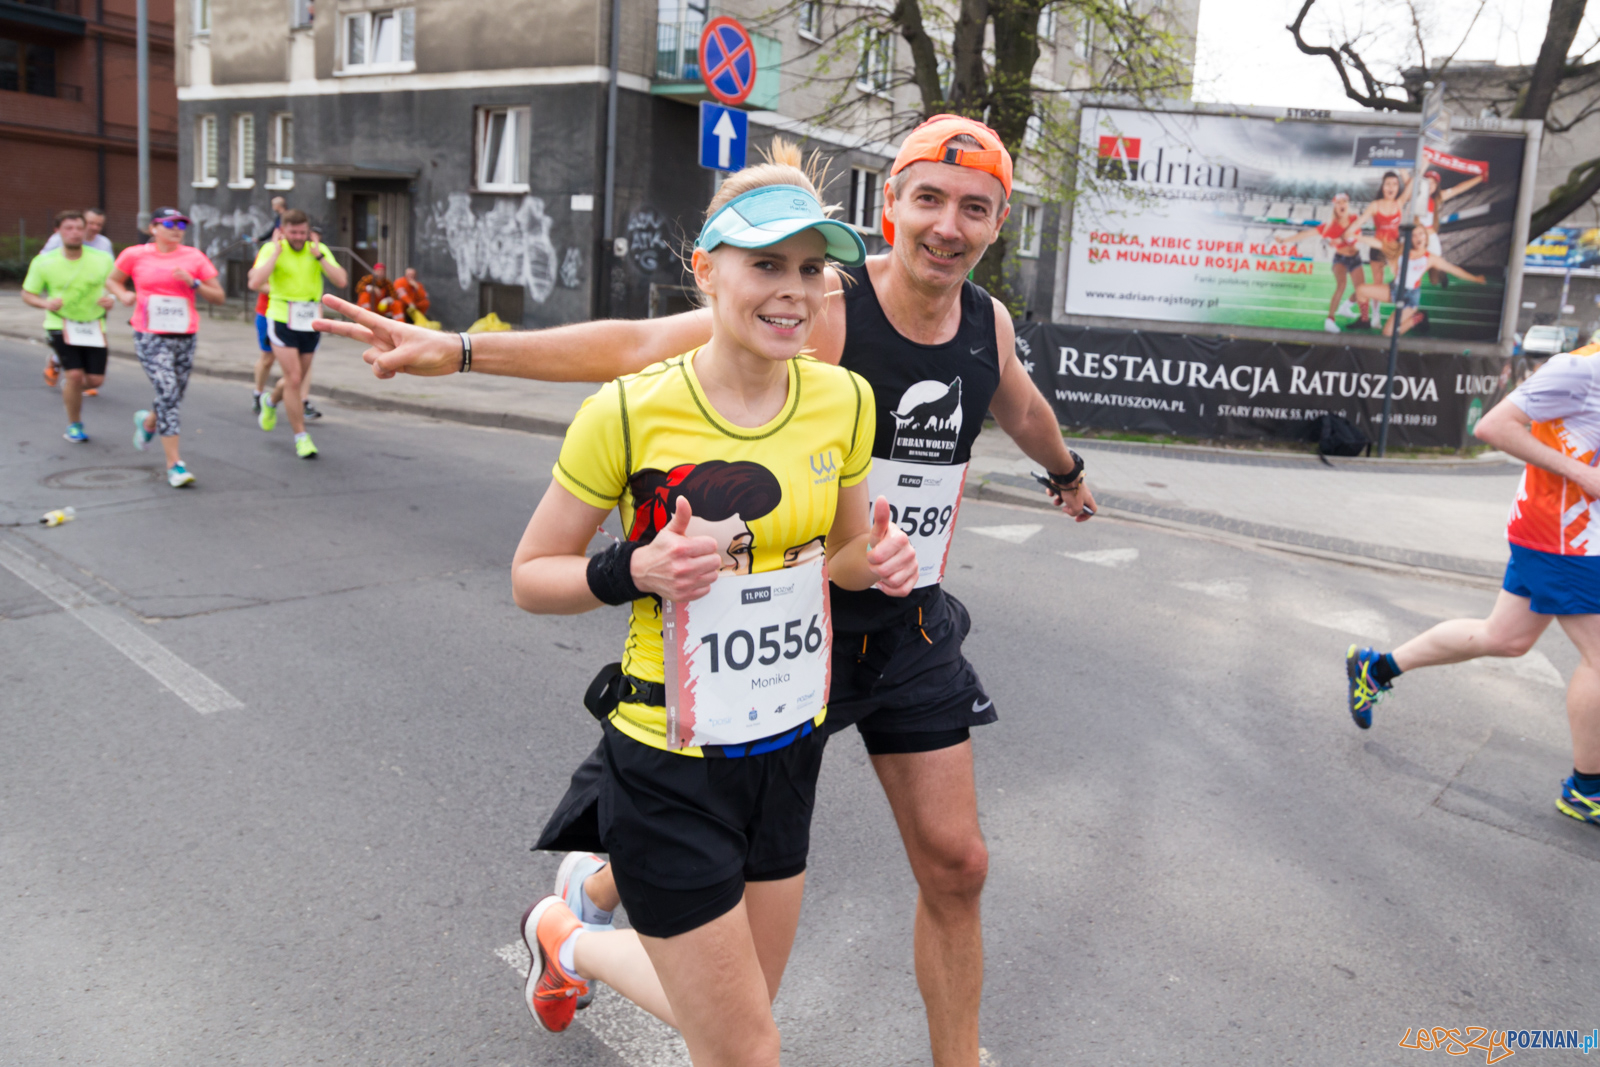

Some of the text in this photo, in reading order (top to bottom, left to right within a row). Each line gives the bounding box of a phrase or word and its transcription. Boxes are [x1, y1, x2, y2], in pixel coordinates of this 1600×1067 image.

[1150, 236, 1192, 250] KIBIC
[1197, 239, 1244, 254] SUPER
[1088, 248, 1314, 275] NA MUNDIALU ROSJA NASZA!
[1086, 288, 1220, 308] www.adrian-rajstopy.pl
[1057, 345, 1281, 399] RESTAURACJA
[1288, 365, 1439, 401] RATUSZOVA
[1055, 389, 1186, 413] WWW.RATUSZOVA.PL
[1217, 404, 1251, 418] STARY
[1252, 406, 1289, 420] RYNEK
[897, 437, 956, 450] URBAN WOLVES
[908, 449, 928, 457] RUNNING
[908, 477, 921, 485] PKO
[869, 501, 953, 537] 0589
[754, 590, 770, 600] PKO
[701, 613, 823, 674] 10556
[751, 672, 791, 690] Monika
